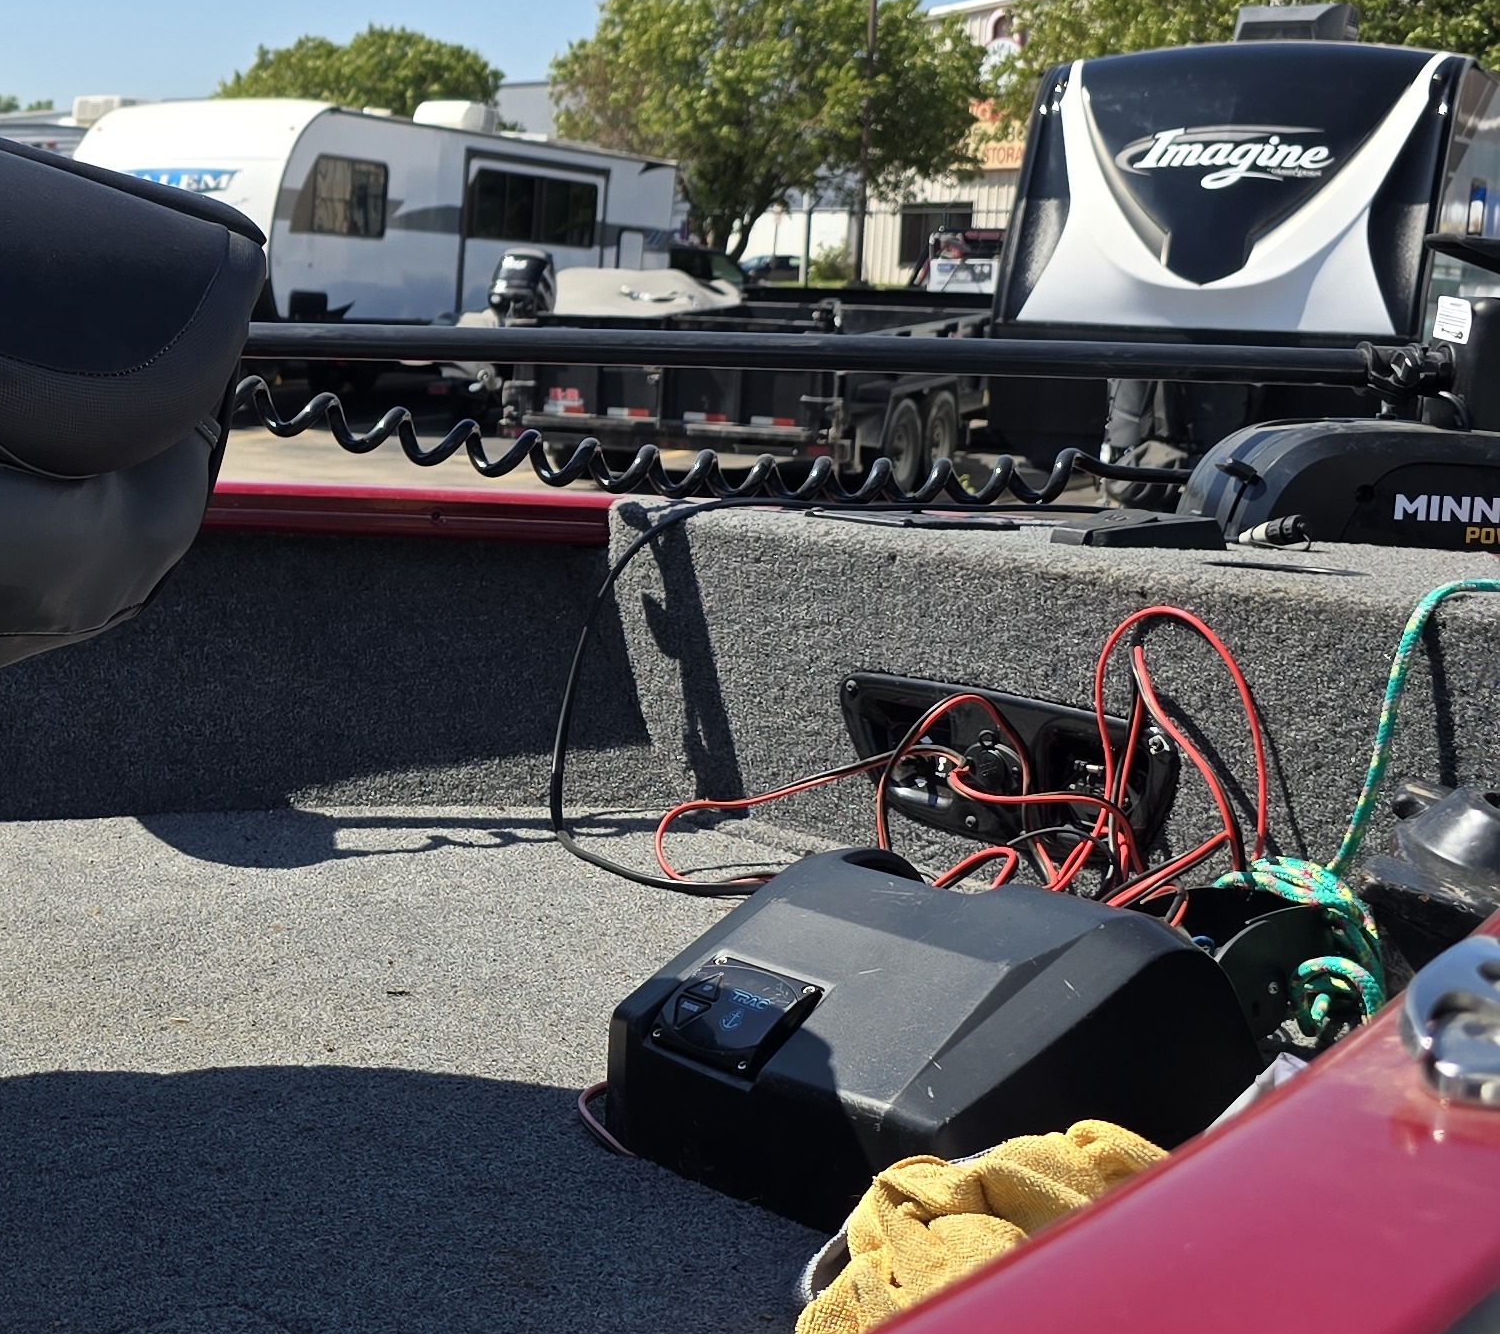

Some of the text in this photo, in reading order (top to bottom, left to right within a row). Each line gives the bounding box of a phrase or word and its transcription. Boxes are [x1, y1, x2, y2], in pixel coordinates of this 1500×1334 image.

[1132, 127, 1335, 190] Imagine
[1393, 493, 1500, 524] MINN
[730, 988, 771, 1011] TRAC
